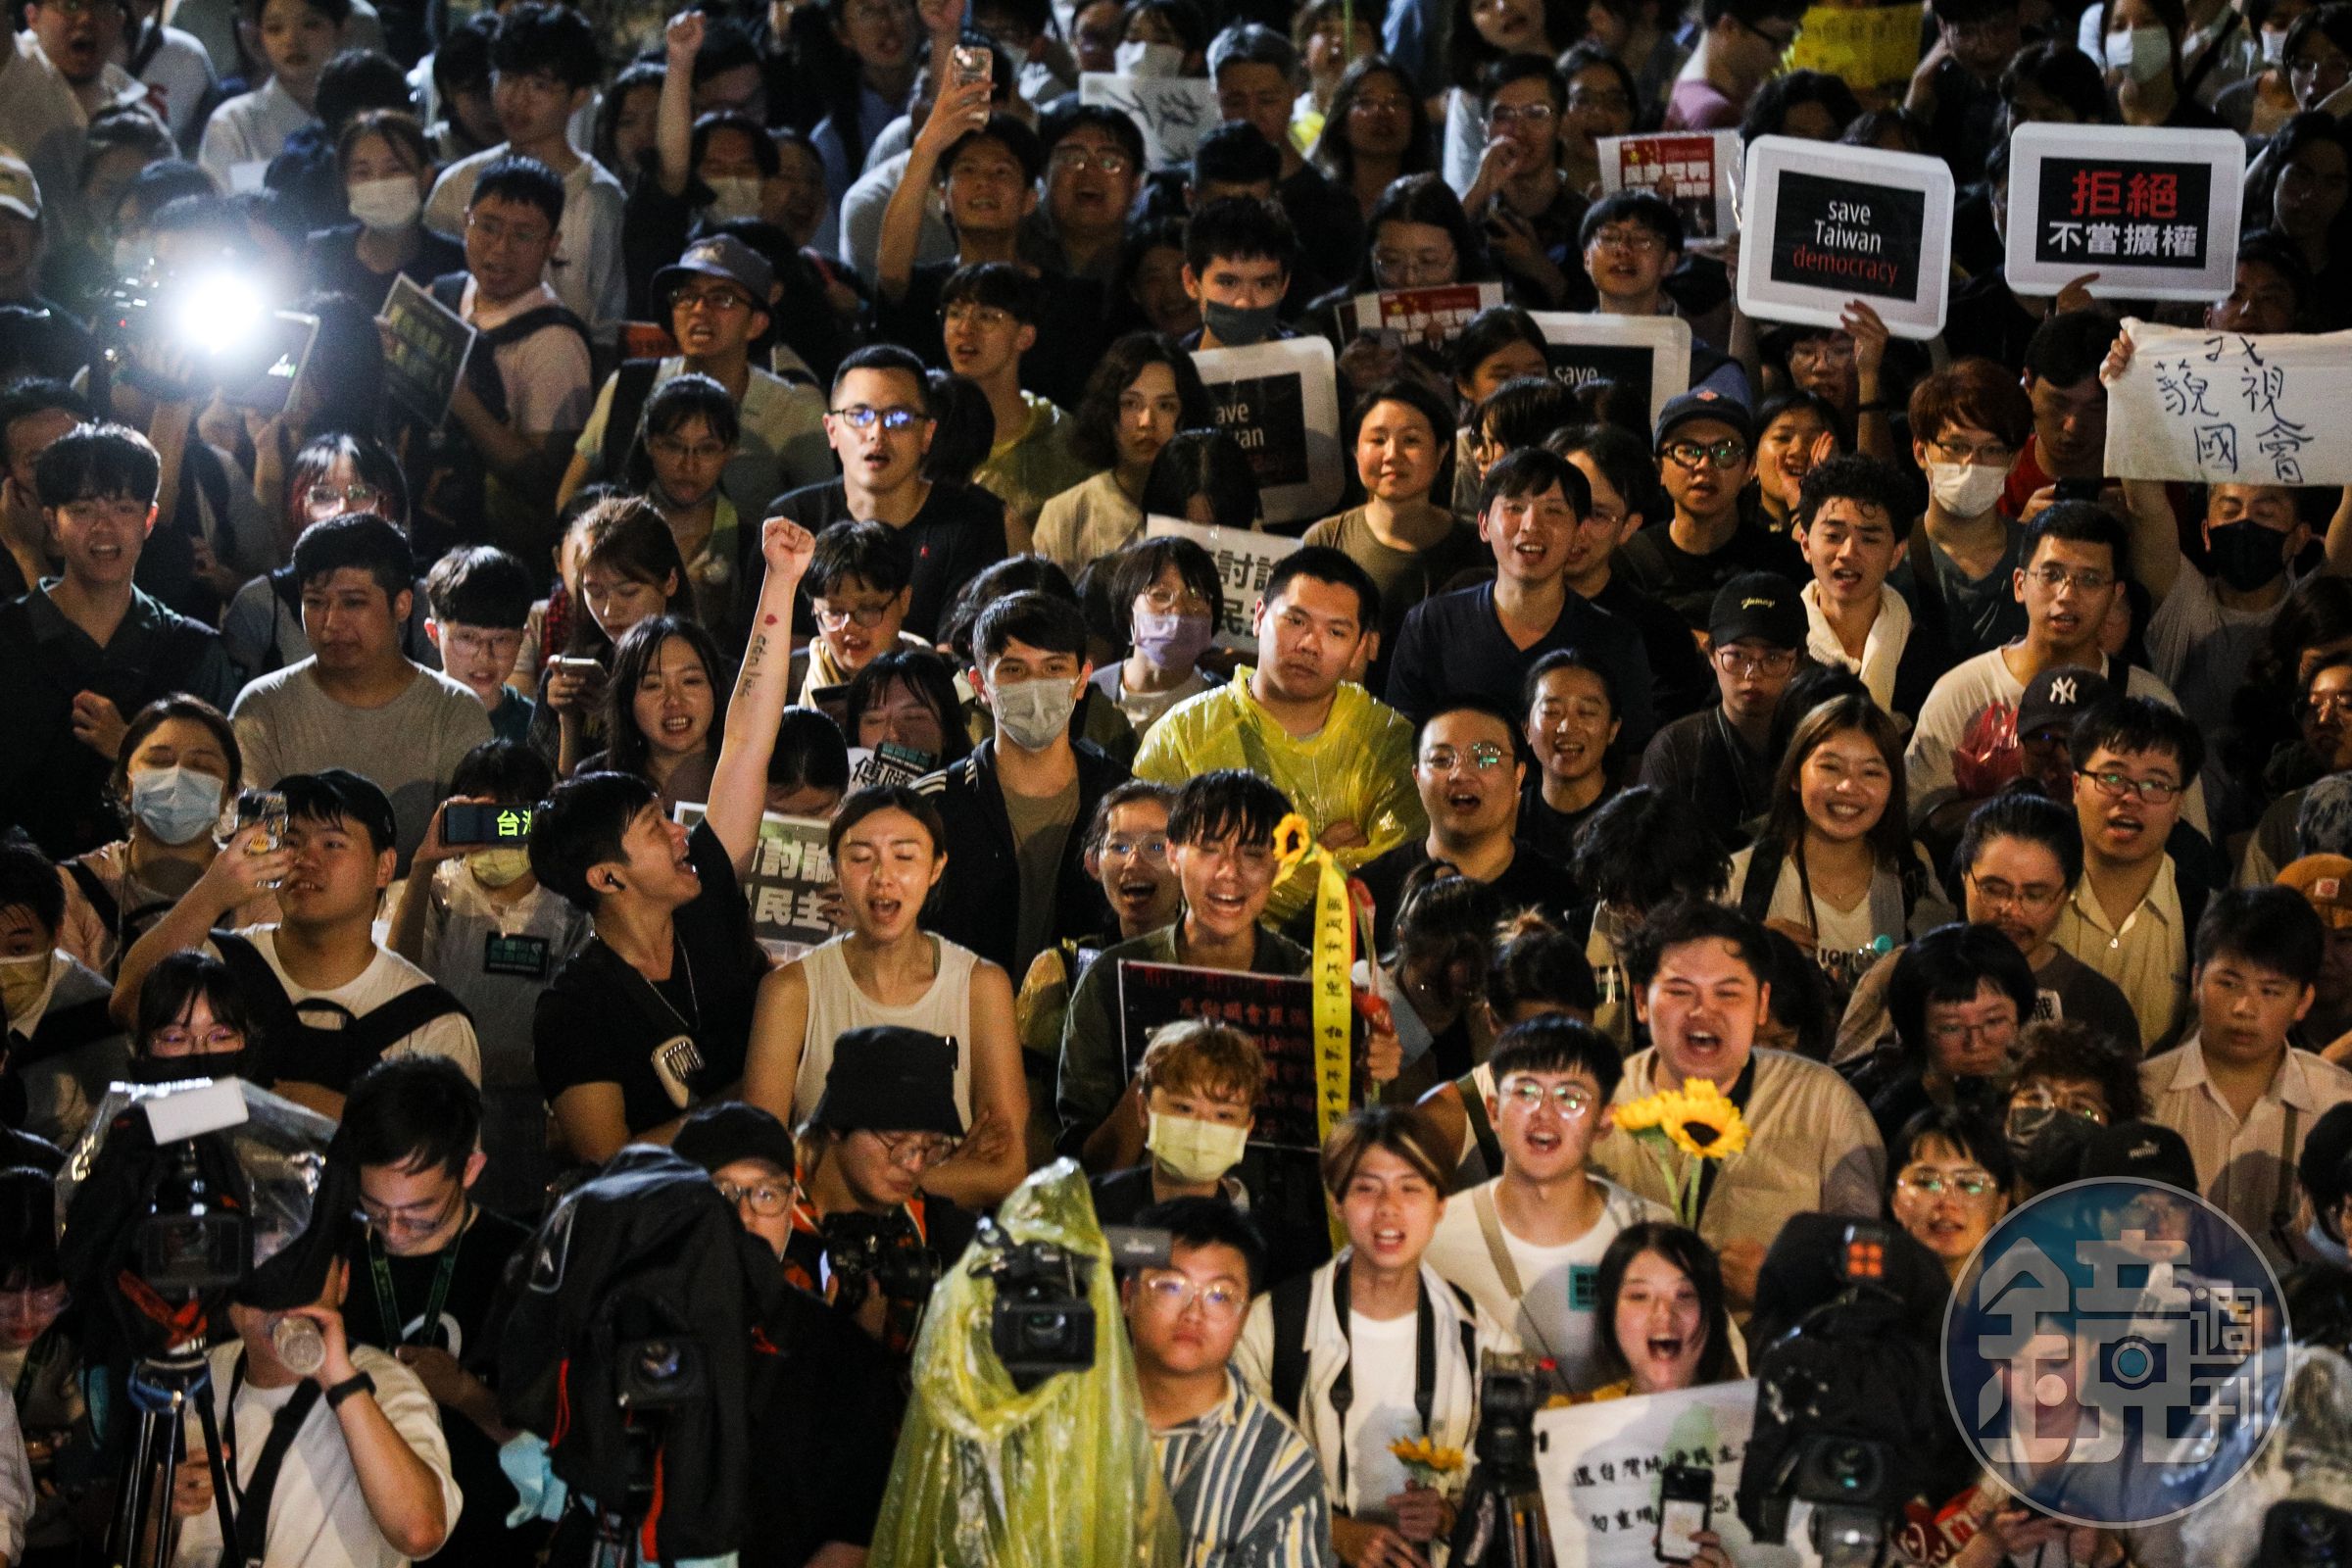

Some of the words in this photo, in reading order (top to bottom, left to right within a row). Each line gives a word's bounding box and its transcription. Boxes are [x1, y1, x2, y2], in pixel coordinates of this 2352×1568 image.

[1828, 199, 1871, 225] save
[2071, 169, 2178, 219] 拒絕
[1814, 219, 1882, 254] Taiwan
[2048, 220, 2198, 257] 不當擴權
[1792, 244, 1898, 287] democracy
[1215, 403, 1249, 424] ave
[2154, 359, 2306, 430] 藐視
[2193, 422, 2314, 484] 國會
[2049, 676, 2078, 705] NY
[751, 838, 835, 882] 討論
[745, 883, 831, 931] 民主
